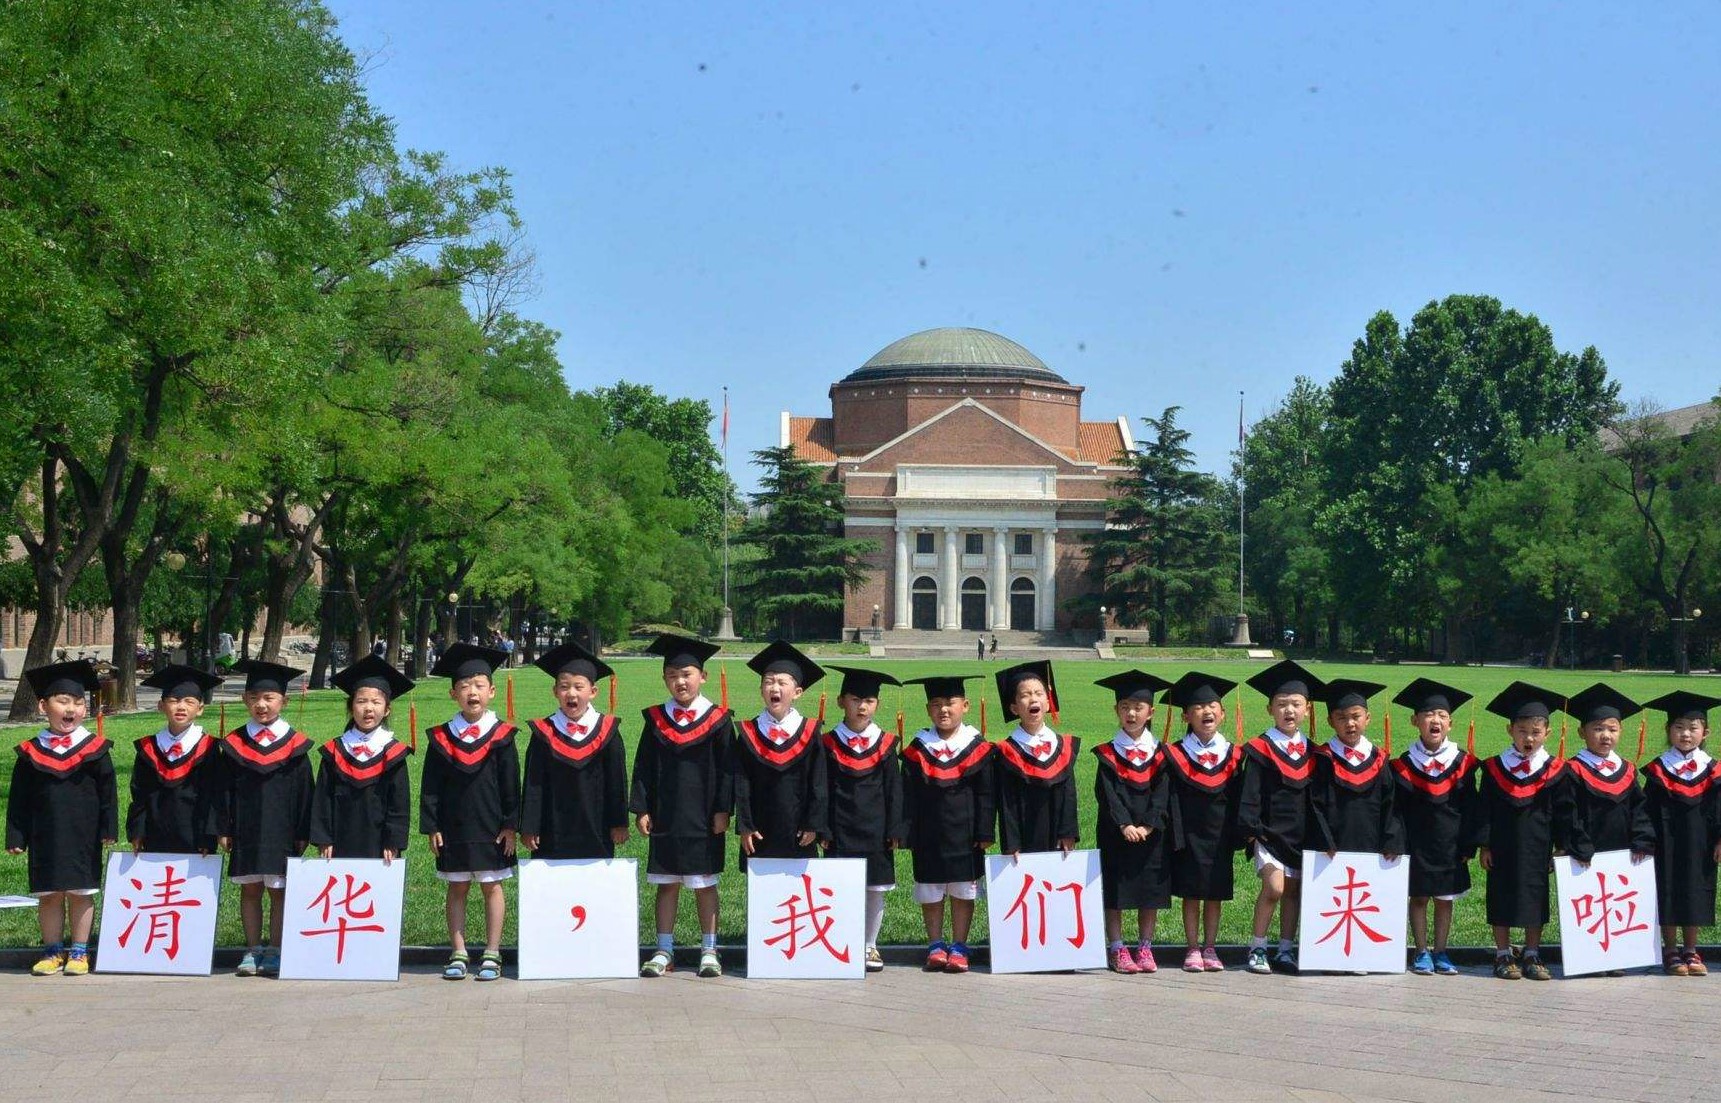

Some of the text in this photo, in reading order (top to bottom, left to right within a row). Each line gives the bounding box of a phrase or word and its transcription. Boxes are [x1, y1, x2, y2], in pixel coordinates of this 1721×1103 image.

[117, 865, 202, 960] 清
[300, 873, 386, 964] 华
[764, 873, 852, 965] 我
[1003, 873, 1087, 951] 们
[1315, 866, 1392, 956] 来
[1571, 871, 1650, 953] 啦
